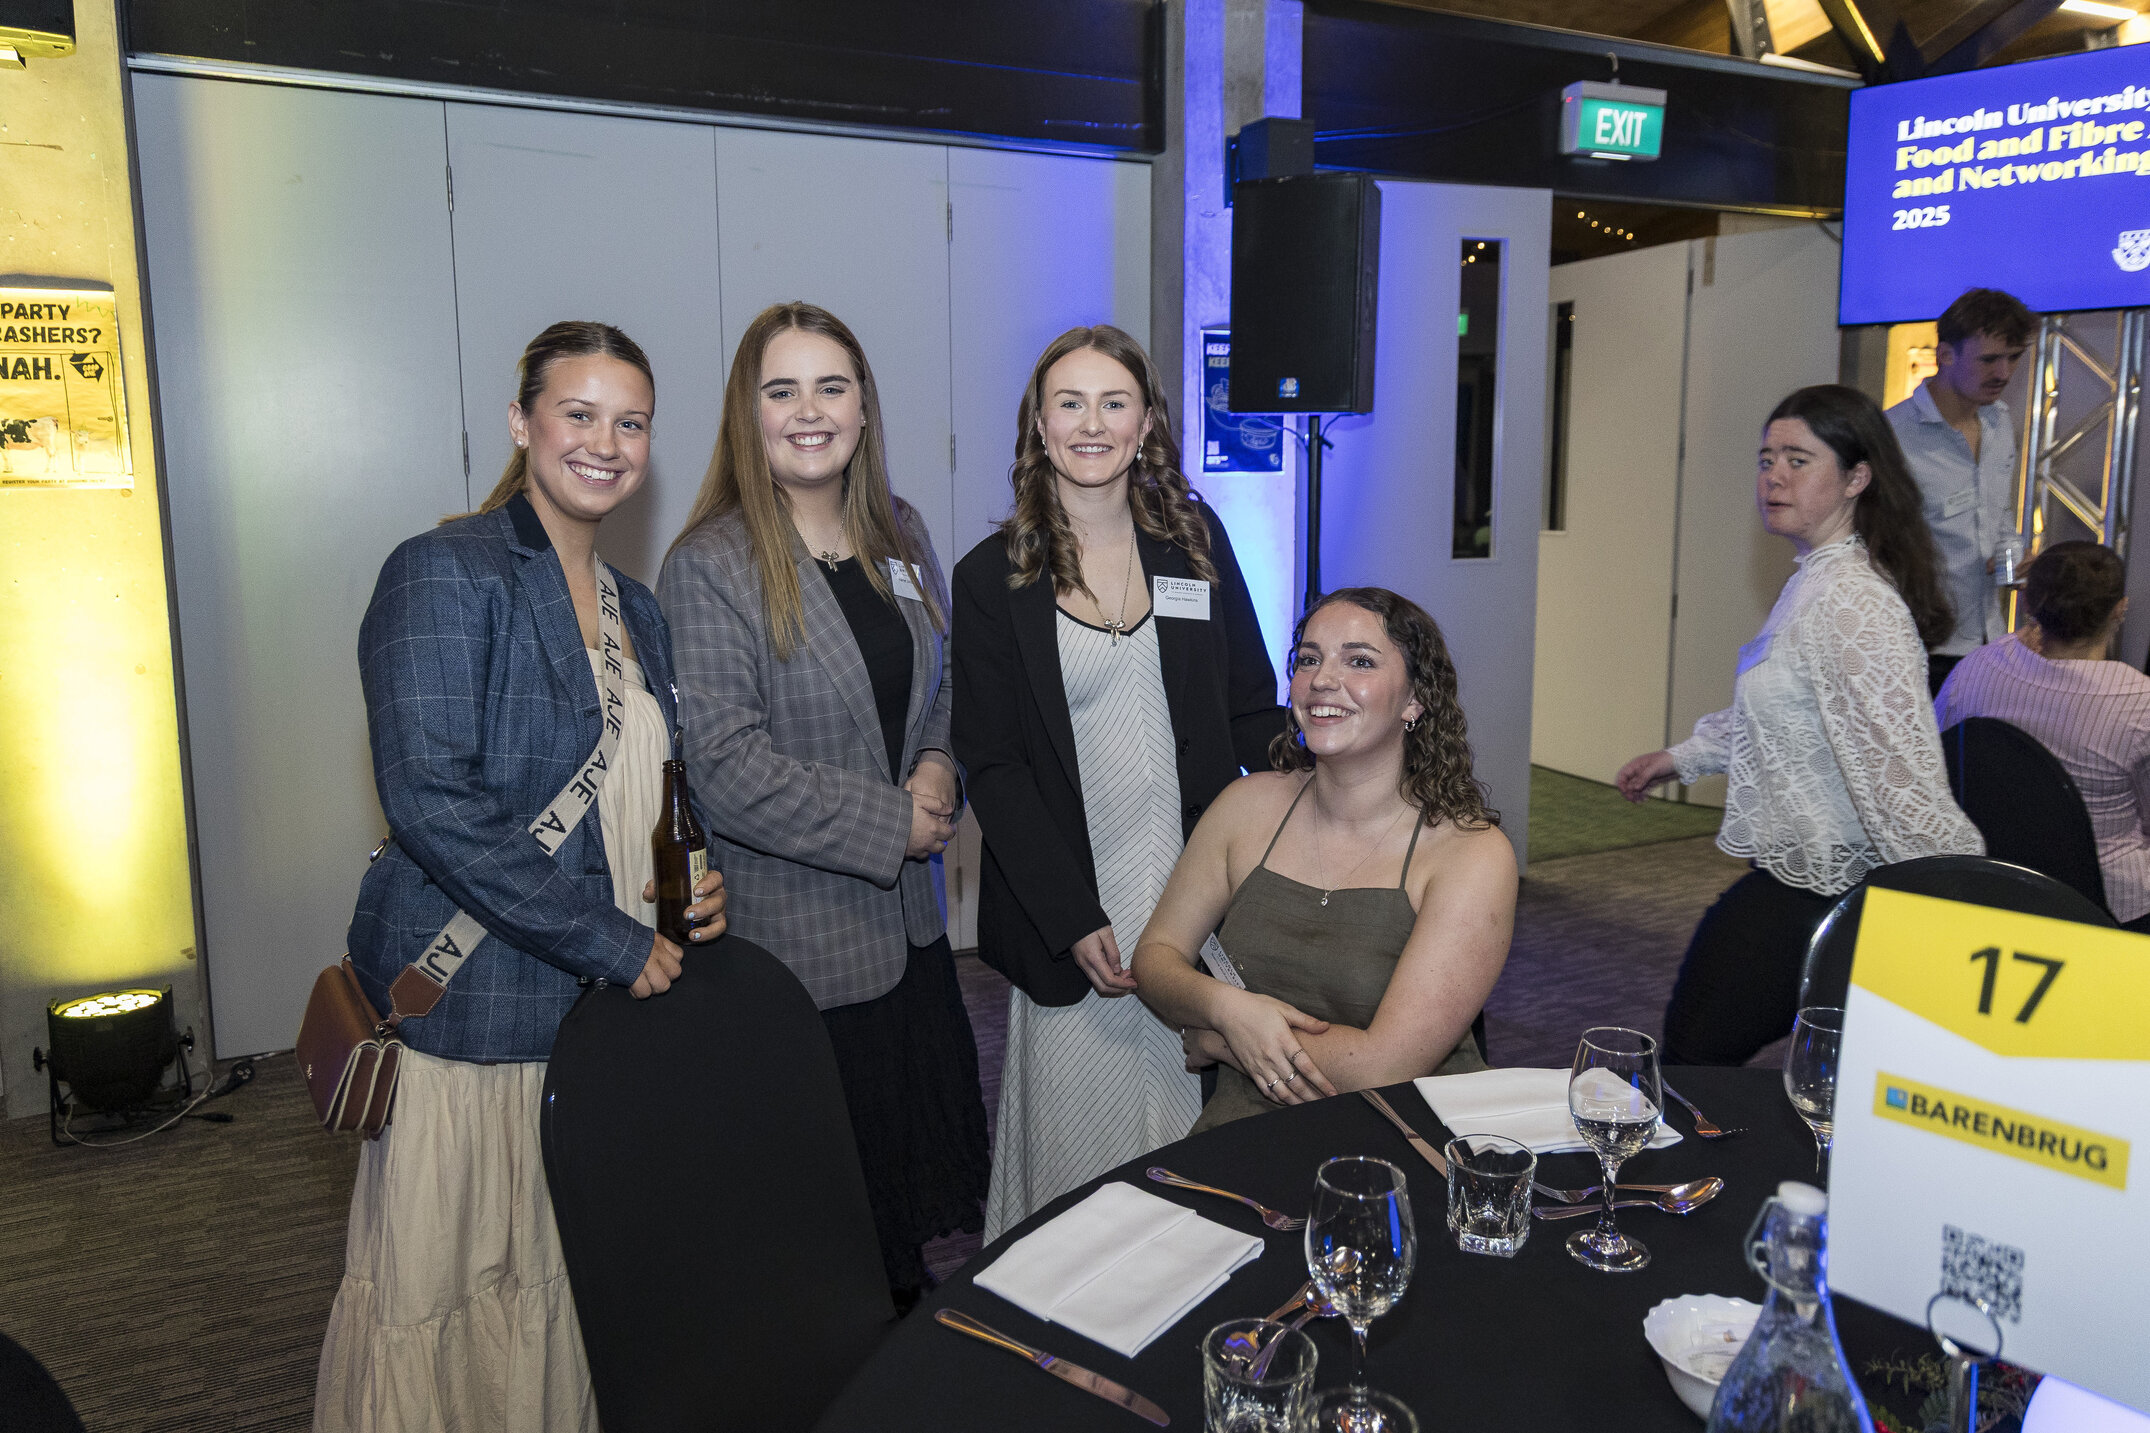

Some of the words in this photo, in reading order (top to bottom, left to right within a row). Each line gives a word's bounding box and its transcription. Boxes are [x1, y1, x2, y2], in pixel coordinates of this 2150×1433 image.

[1595, 107, 1648, 147] EXIT
[1895, 137, 1975, 171] Food
[1977, 127, 2043, 161] and
[2047, 120, 2146, 152] Fibre
[1897, 108, 2003, 142] Lincoln
[1892, 168, 1954, 199] and
[1958, 147, 2150, 192] Networking
[1891, 205, 1950, 231] 2025
[0, 303, 71, 320] PARTY
[0, 326, 102, 344] ASHERS?
[600, 579, 618, 625] AJE
[603, 632, 623, 679] AJE
[605, 688, 623, 741] AJE
[569, 750, 608, 806] AJE
[1969, 945, 2066, 1025] 17
[1910, 1092, 2108, 1172] BARENBRUG
